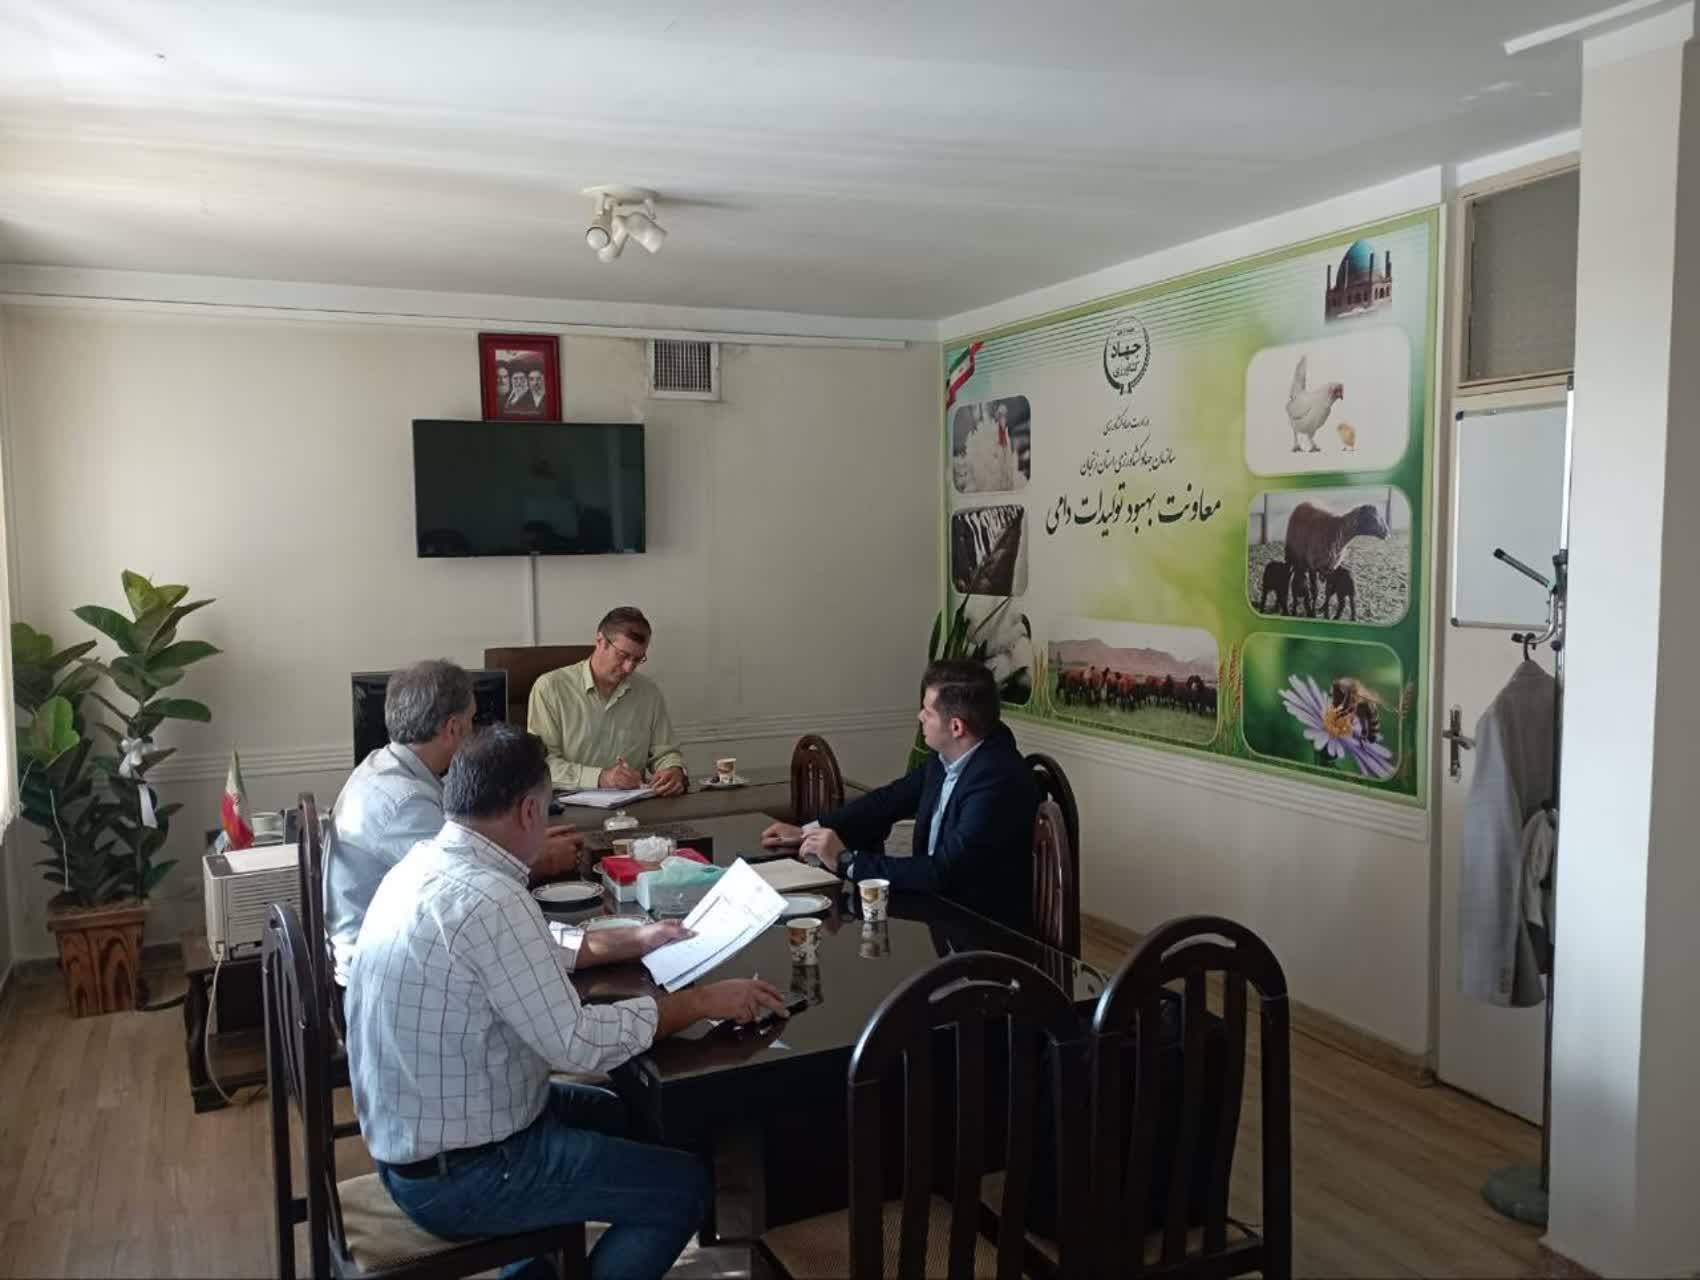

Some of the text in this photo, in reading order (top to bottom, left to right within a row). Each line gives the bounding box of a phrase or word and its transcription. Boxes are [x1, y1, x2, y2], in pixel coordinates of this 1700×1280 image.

[1111, 342, 1141, 360] جهاد
[1080, 451, 1098, 477] زنجان
[1096, 449, 1115, 475] استان
[1152, 447, 1176, 471] سازمان
[1046, 481, 1221, 537] معاونت بهبود تولیدات دامی
